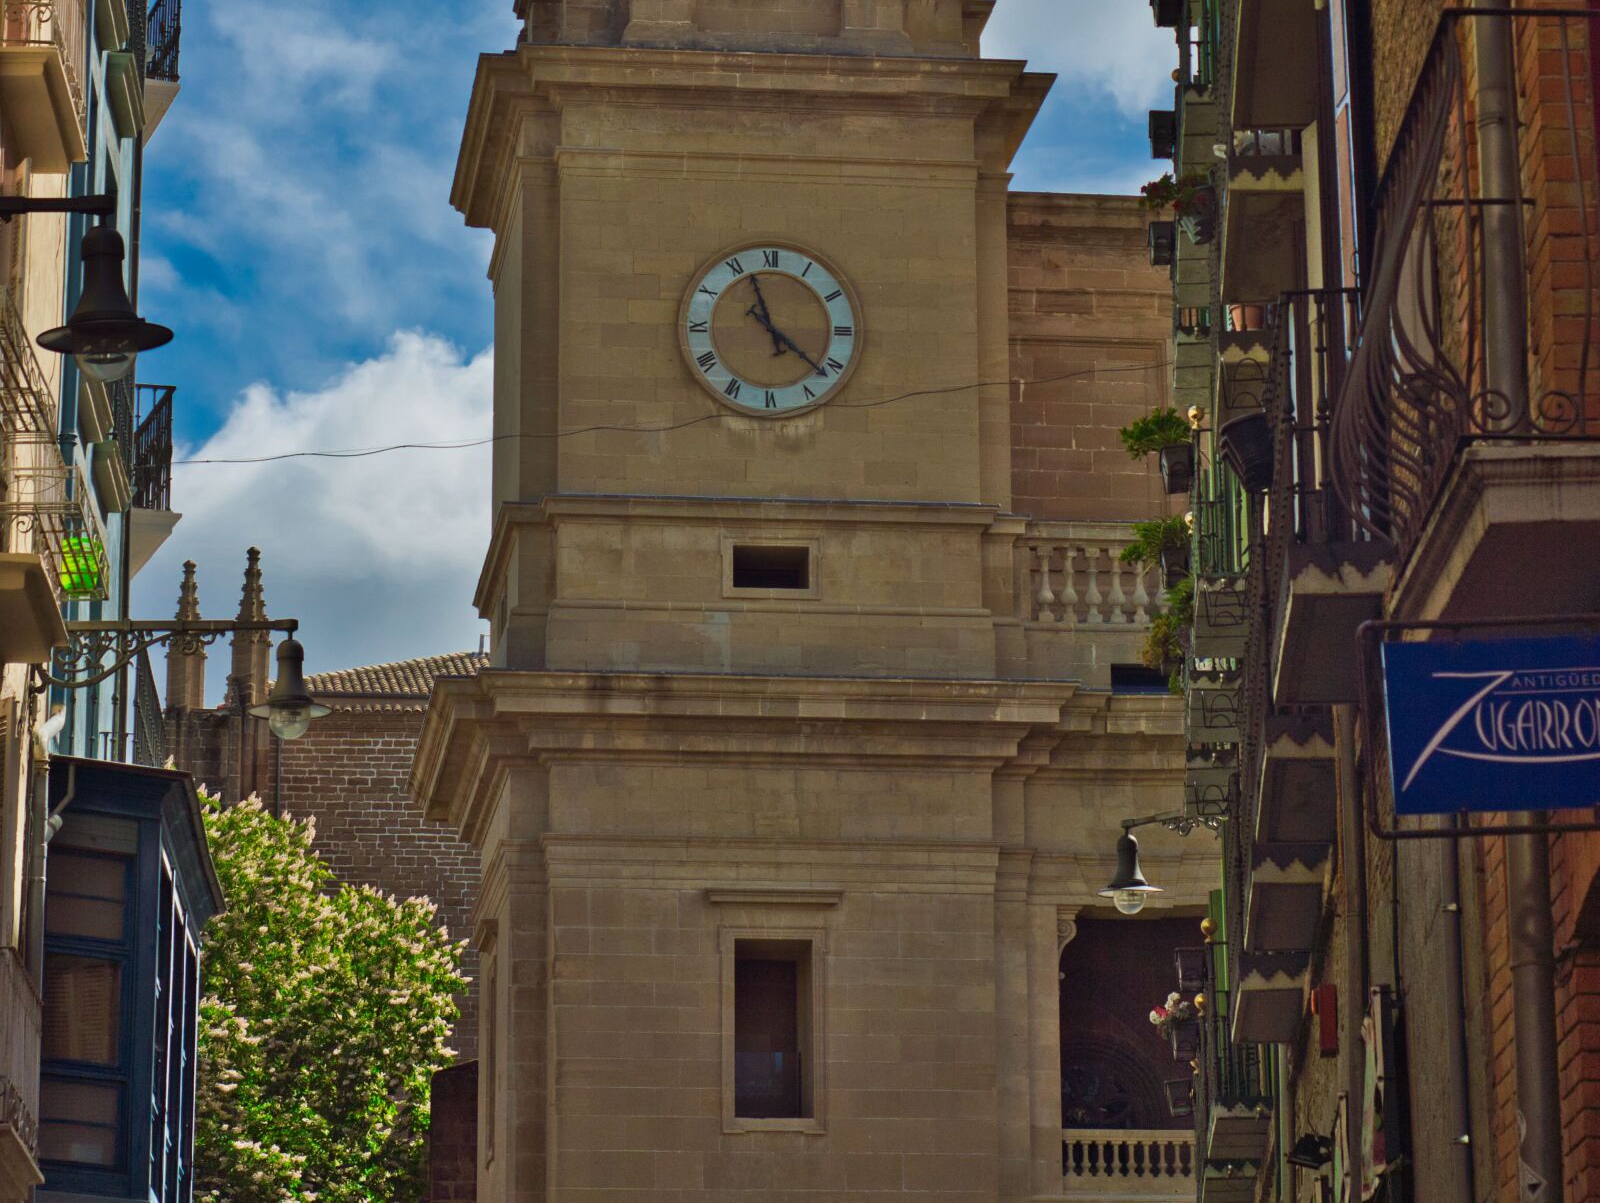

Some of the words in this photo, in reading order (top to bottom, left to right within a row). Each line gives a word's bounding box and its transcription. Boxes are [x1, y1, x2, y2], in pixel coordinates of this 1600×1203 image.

[725, 257, 744, 277] XI
[763, 250, 779, 268] XII
[802, 262, 812, 277] I
[699, 285, 718, 300] X
[824, 290, 842, 302] II
[689, 320, 708, 332] IX
[834, 326, 852, 336] III
[697, 350, 717, 373] VIII
[826, 357, 844, 375] IV
[724, 377, 741, 399] VII
[803, 384, 815, 400] V
[765, 390, 777, 408] VI
